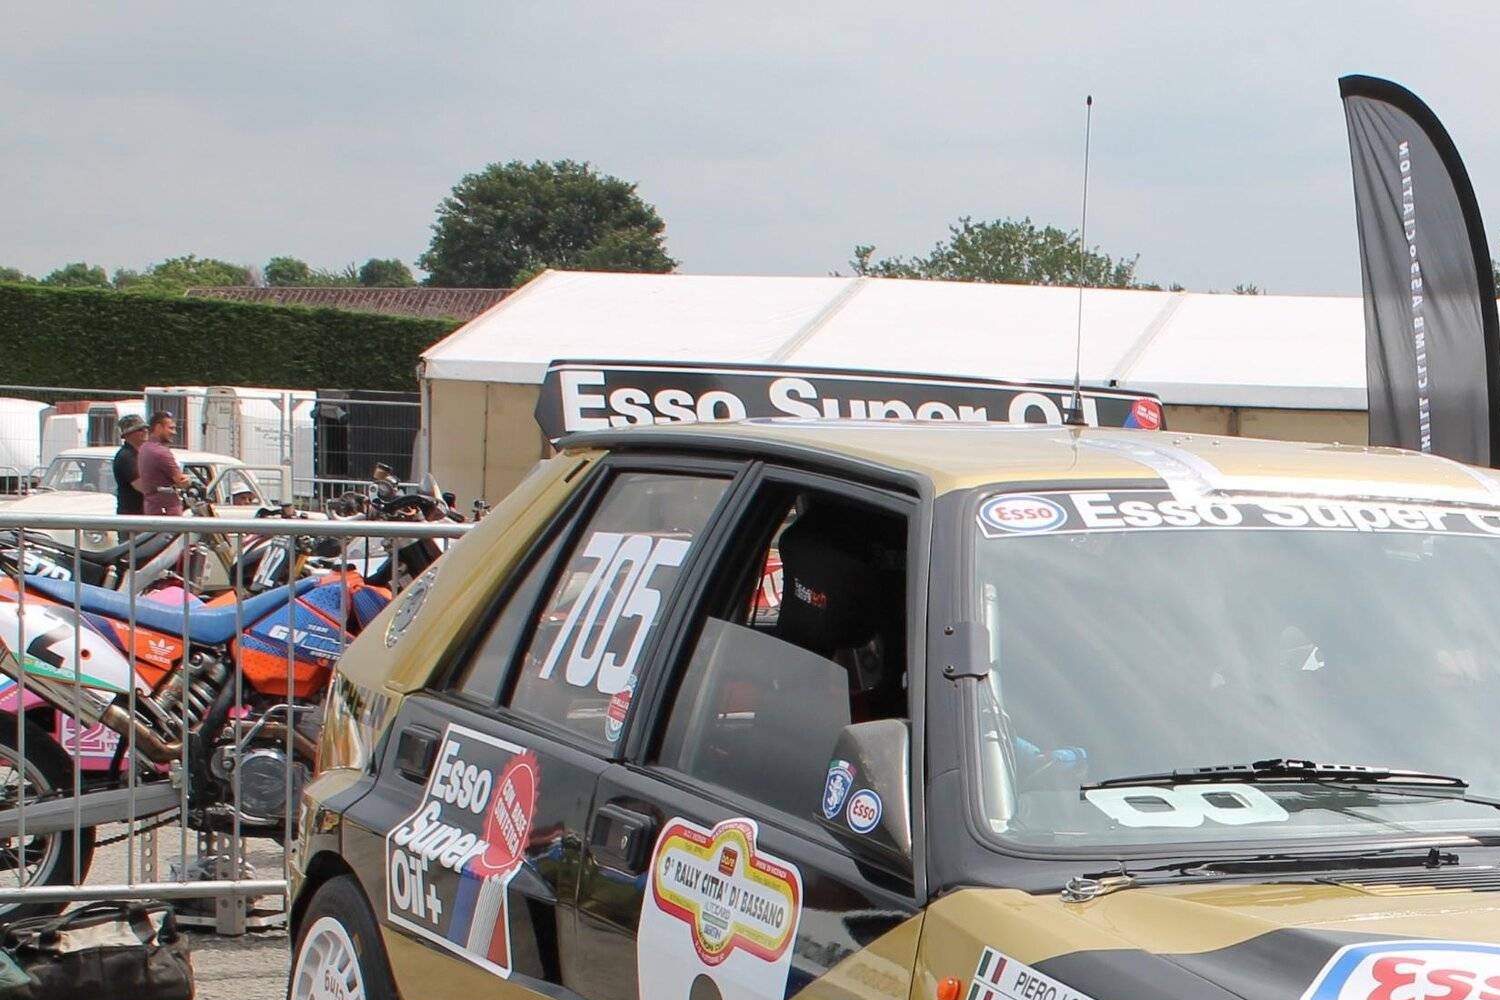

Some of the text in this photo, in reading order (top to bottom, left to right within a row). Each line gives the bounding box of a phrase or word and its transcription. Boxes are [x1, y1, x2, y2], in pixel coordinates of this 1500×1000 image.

[560, 370, 748, 432] Esso
[1069, 493, 1244, 528] Esso
[539, 531, 693, 696] 705
[431, 740, 493, 814] Esso
[394, 800, 491, 873] Super
[674, 861, 702, 894] RALLY
[728, 885, 742, 909] DI
[739, 892, 785, 930] BASSANO
